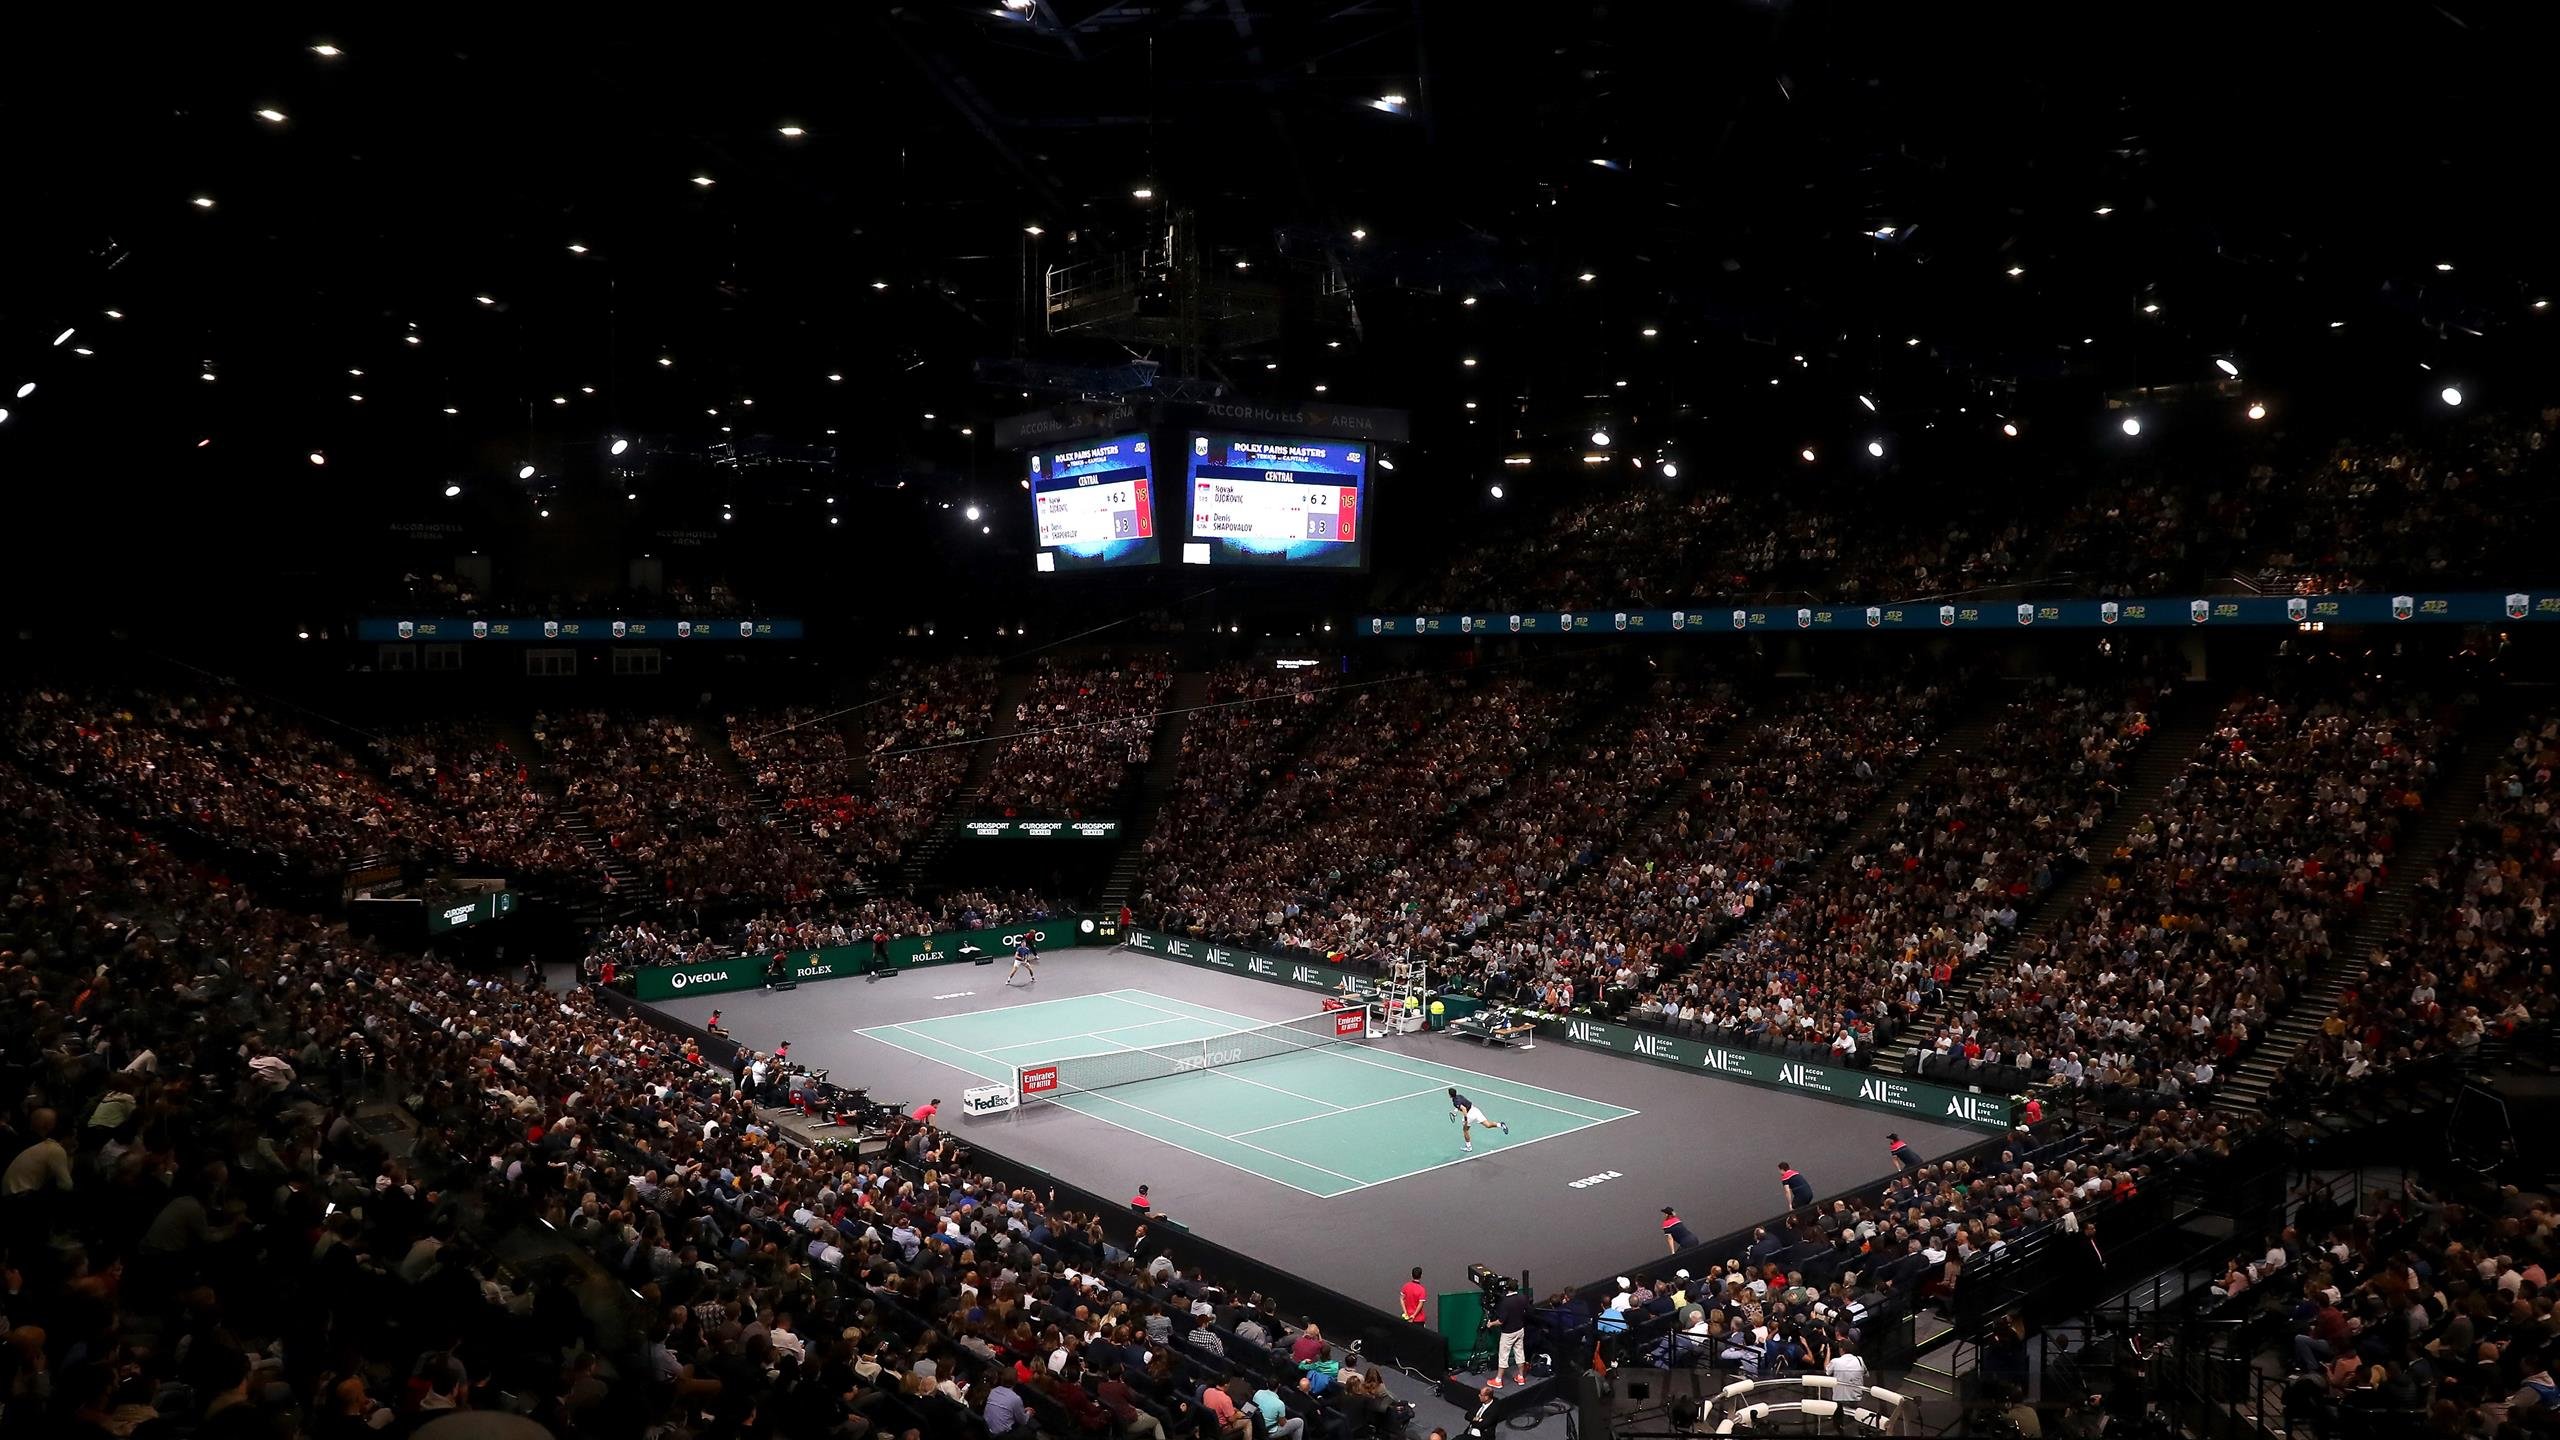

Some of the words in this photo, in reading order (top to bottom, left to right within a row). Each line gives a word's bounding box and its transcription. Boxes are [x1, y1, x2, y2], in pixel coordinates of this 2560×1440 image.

[1331, 415, 1373, 430] ARENA
[1055, 452, 1074, 463] ROLEX
[1074, 449, 1091, 460] PARIS
[1091, 445, 1119, 458] MASTERS
[1234, 443, 1263, 453] ROLEX
[1263, 445, 1288, 455] PARIS
[1288, 447, 1326, 458] MASTERS
[1078, 475, 1099, 487] CENTRAL
[1265, 471, 1294, 483] CENTRAL
[1113, 492, 1119, 503] 6
[1120, 491, 1126, 503] 2
[1136, 488, 1147, 502] 15
[1310, 495, 1317, 505] 6
[1321, 494, 1327, 505] 2
[1341, 495, 1355, 508] 15
[1213, 512, 1231, 522] Denis
[1141, 518, 1148, 530] 0
[1213, 522, 1253, 532] SHAPOVALOV
[1318, 520, 1327, 534] 3
[1342, 522, 1351, 535] 0
[966, 822, 1010, 830] EUROSPORT
[1019, 822, 1062, 830] EUROSPORT
[1071, 822, 1115, 830] EUROSPORT
[1002, 931, 1046, 948] opo
[912, 951, 945, 963] ROLEX
[1206, 948, 1220, 964] All
[1248, 956, 1263, 973] All
[797, 965, 832, 977] ROLEX
[1292, 965, 1308, 983] All
[688, 972, 729, 984] VEOLIA
[1341, 975, 1356, 993] All
[1338, 1016, 1362, 1025] Emirates
[1568, 1021, 1590, 1042] All
[1589, 1038, 1611, 1046] LIMITLESS
[1633, 1033, 1656, 1056] All
[1206, 1047, 1241, 1066] TOUR
[1656, 1052, 1679, 1060] LIMITLESS
[1703, 1048, 1728, 1071] All
[1024, 1070, 1055, 1084] Emirates
[1728, 1066, 1752, 1076] LIMITLESS
[1778, 1062, 1804, 1086] All
[1805, 1068, 1824, 1076] ACCOR
[1036, 1079, 1051, 1089] BETTER
[1805, 1082, 1831, 1091] LIMITLESS
[1888, 1084, 1908, 1092] ACCOR
[1858, 1078, 1887, 1103] All
[974, 1094, 1009, 1111] FedEx
[1887, 1098, 1916, 1108] LIMITLESS
[1945, 1095, 1977, 1120] All
[1977, 1101, 1999, 1110] ACCOR
[1977, 1116, 2008, 1127] LIMITLESS
